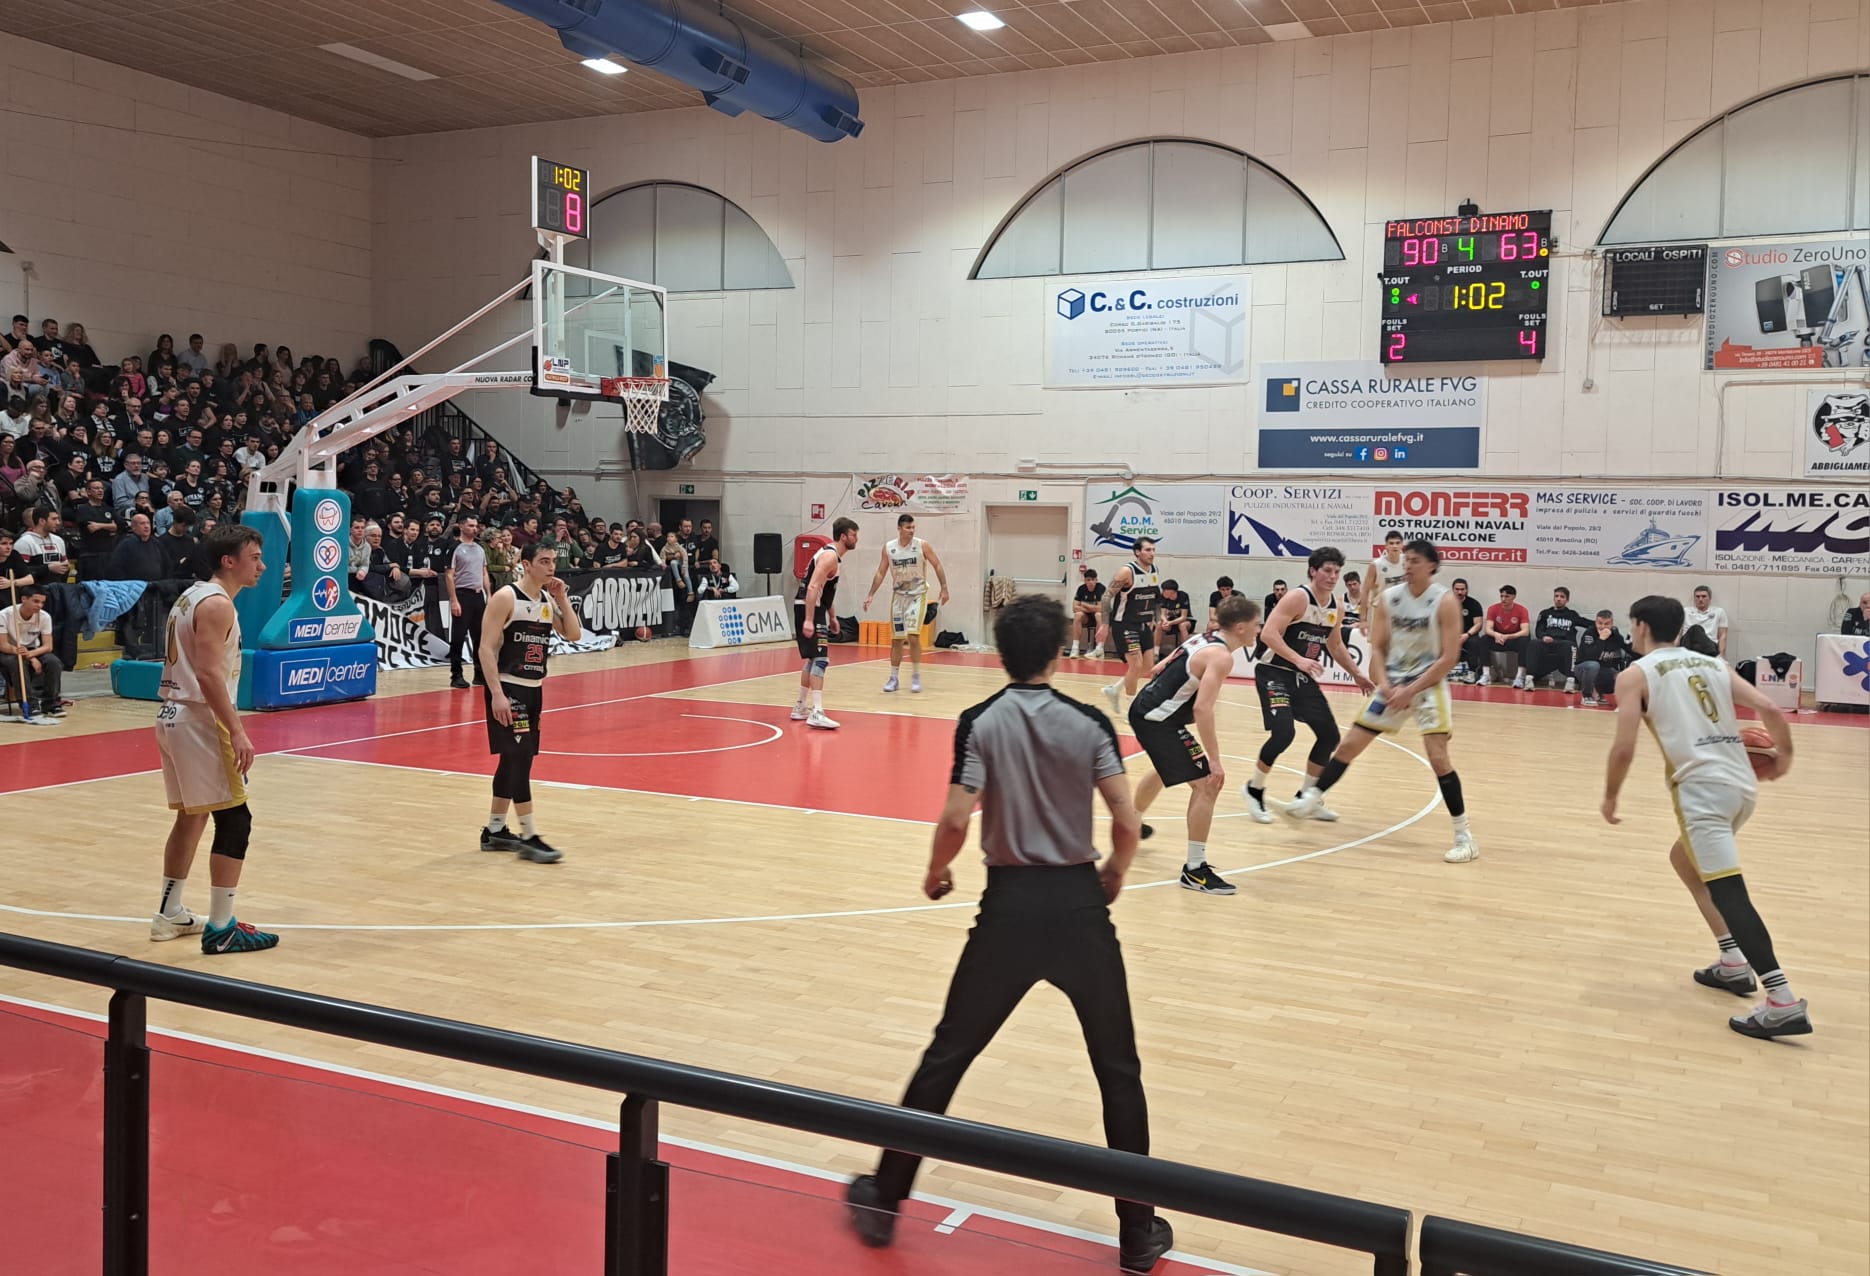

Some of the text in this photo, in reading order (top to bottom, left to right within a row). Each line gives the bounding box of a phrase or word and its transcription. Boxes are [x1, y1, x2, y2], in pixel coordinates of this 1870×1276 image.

[554, 167, 581, 191] 1:02
[565, 192, 581, 232] 8
[1388, 214, 1529, 238] FALCONST DINAMO
[1404, 238, 1438, 265] 90
[1458, 237, 1474, 260] 4
[1501, 231, 1538, 260] 63
[1616, 249, 1702, 262] LOCALI OSPITI
[1725, 246, 1867, 268] Studio ZeroUno
[1447, 265, 1482, 274] PERIOD
[1520, 270, 1548, 278] T.OUT
[1157, 293, 1239, 310] costruzioni
[1453, 282, 1505, 310] 1:02
[1389, 333, 1406, 360] 2
[1519, 330, 1536, 354] 4
[1305, 376, 1477, 395] CASSA RURALE FVG
[1306, 398, 1476, 409] CREDITO COOPERATIVO ITALIANO
[1310, 432, 1424, 444] www.cassaruralefvg.it
[857, 475, 915, 499] PIZZERIA
[1231, 486, 1342, 499] COOP. SERVIZI
[1374, 491, 1530, 518] MONFERR
[1536, 492, 1564, 504] MAS
[1566, 493, 1617, 505] SERVICE
[1646, 499, 1666, 507] COOP.
[1120, 516, 1154, 526] A.D.M.
[1648, 509, 1676, 517] guardia
[1120, 526, 1158, 535] Service
[1378, 519, 1470, 530] COSTRUZIONI
[1474, 520, 1525, 531] NAVALI
[1404, 531, 1497, 543] MONFALCONE
[1715, 554, 1766, 562] ISOLAZIONE
[1772, 555, 1825, 563] MECCANICA
[294, 620, 360, 637] MEDI center
[746, 611, 785, 634] GMA
[525, 644, 544, 663] 25
[288, 661, 370, 686] MEDI center
[1688, 675, 1718, 723] 6
